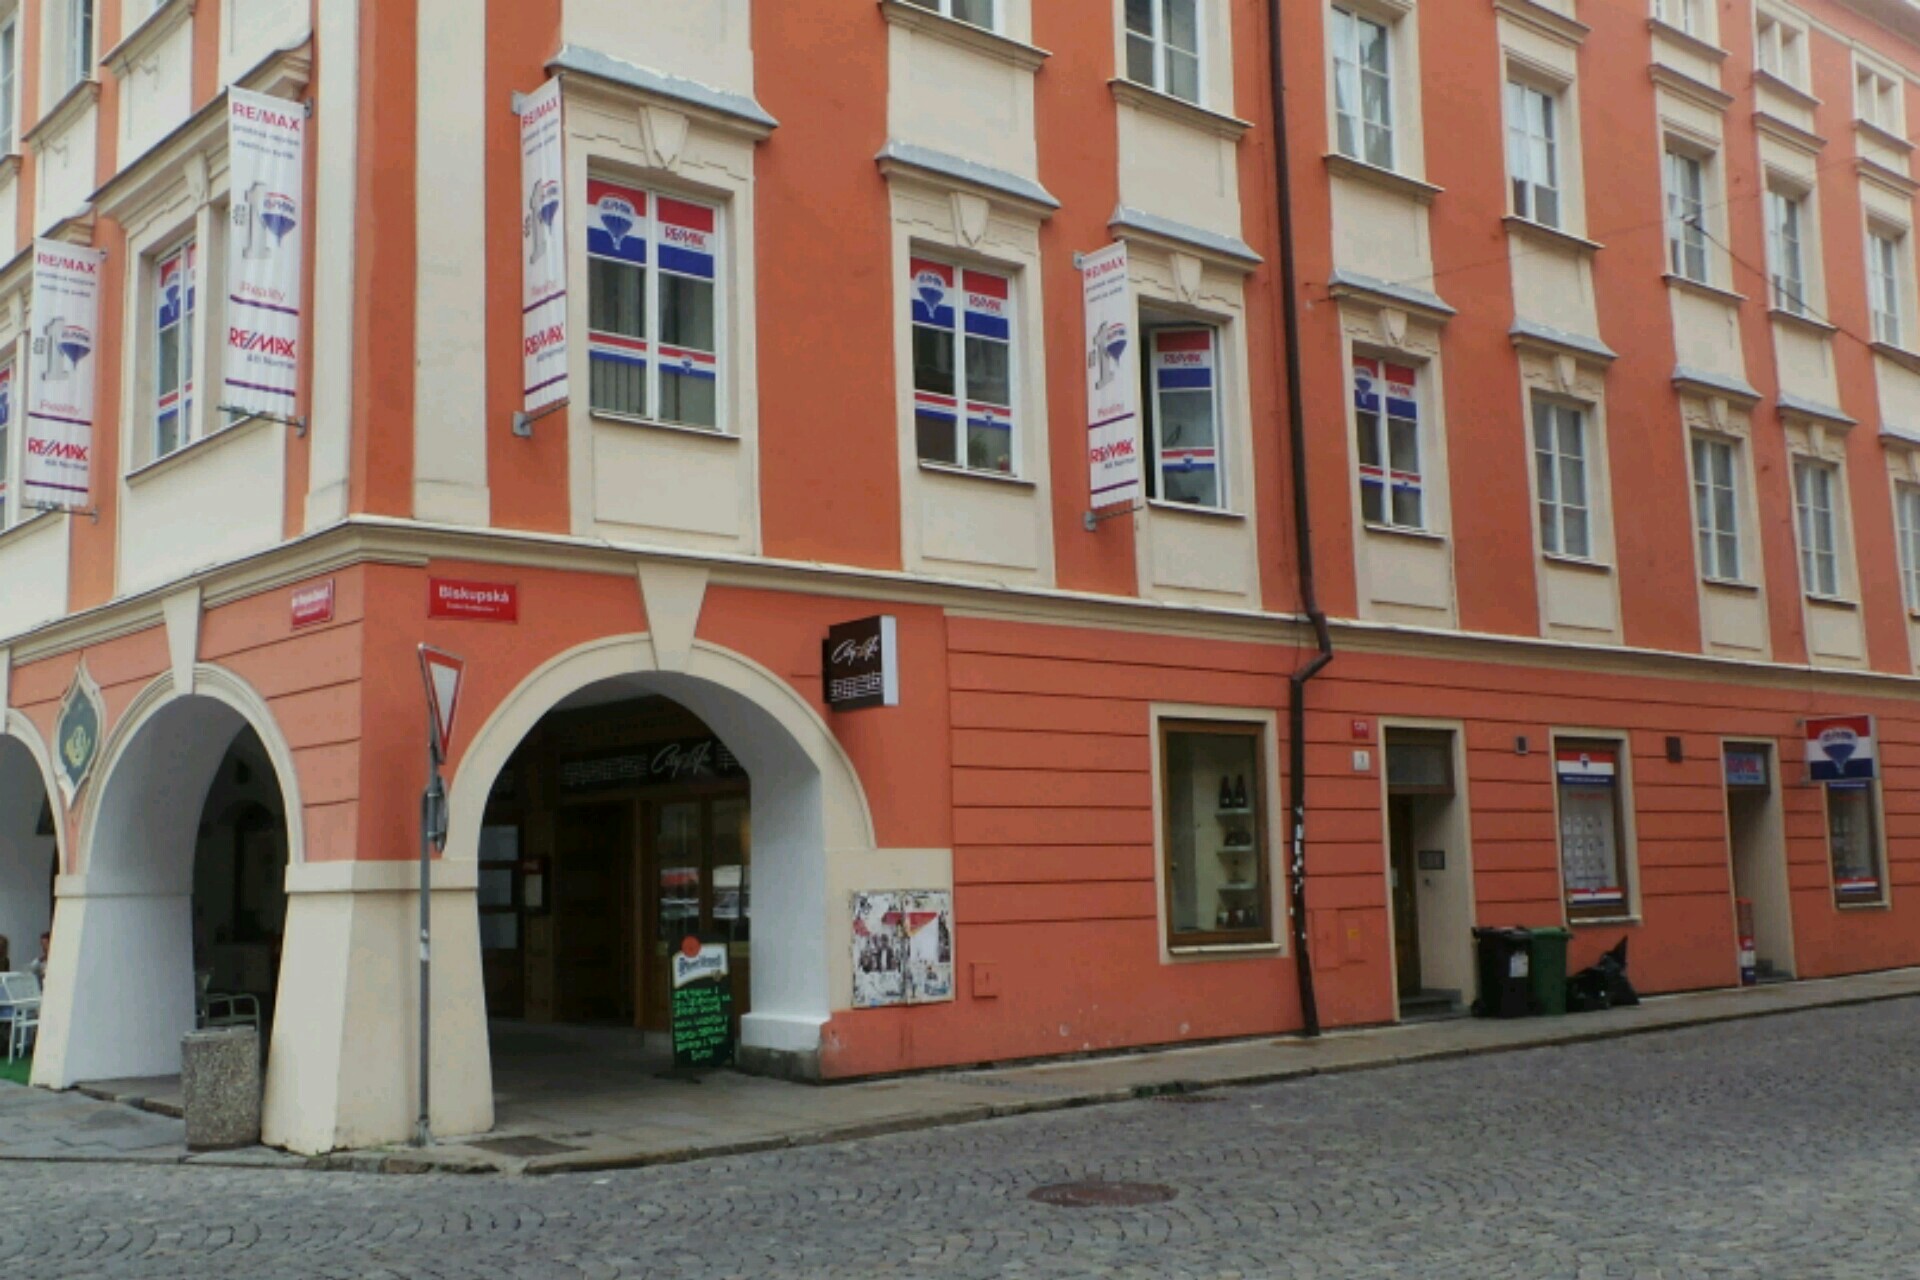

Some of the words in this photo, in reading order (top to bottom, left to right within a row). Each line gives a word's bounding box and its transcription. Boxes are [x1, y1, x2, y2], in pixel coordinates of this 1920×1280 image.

[232, 102, 300, 132] RE/MAX
[665, 225, 705, 246] RE/MAX
[37, 252, 96, 275] RE/MAX
[228, 326, 296, 359] RE/MAX
[524, 322, 565, 357] RE/MAX
[28, 437, 88, 461] RE/MAX
[1090, 438, 1134, 463] RE/MAX
[439, 585, 509, 604] Biskupská
